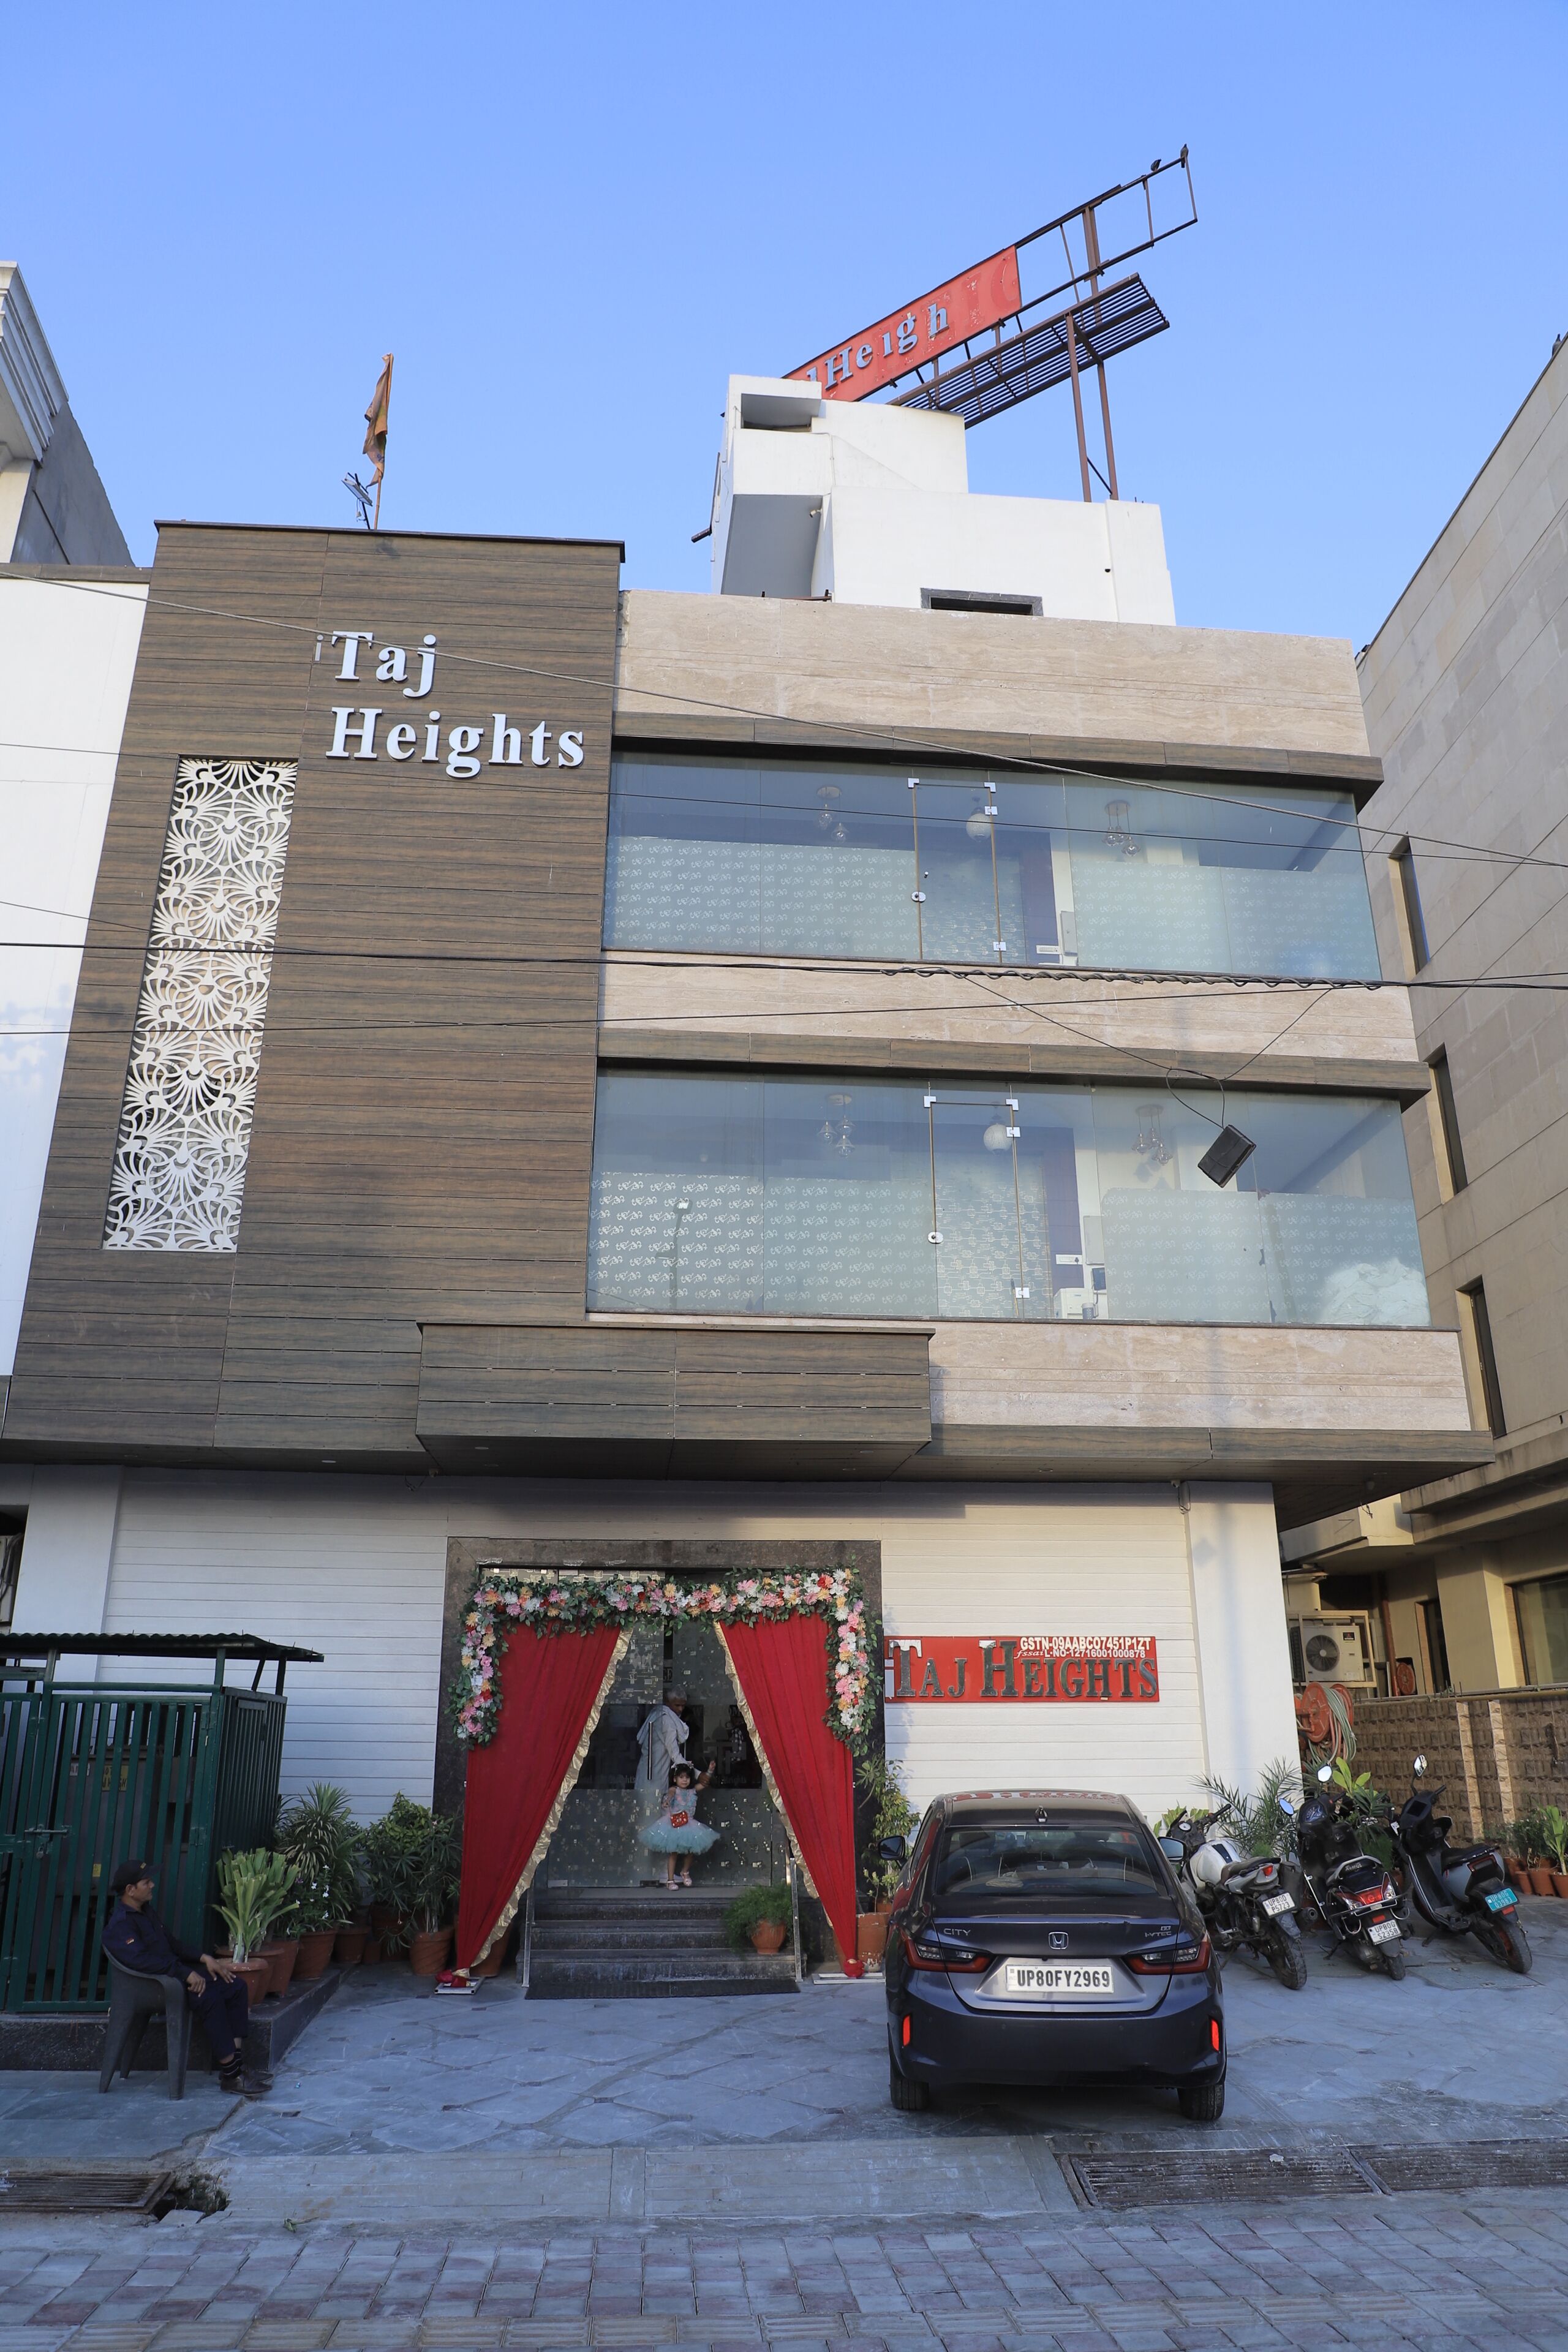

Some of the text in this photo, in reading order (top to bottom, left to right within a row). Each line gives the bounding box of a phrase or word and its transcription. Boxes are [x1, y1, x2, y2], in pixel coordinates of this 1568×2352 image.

[326, 707, 584, 778] Heights
[1268, 1894, 1287, 1906] UP80D
[1271, 1901, 1290, 1913] P5723
[1378, 1928, 1398, 1940] S2358
[1017, 1970, 1110, 1988] UP80FY2969
